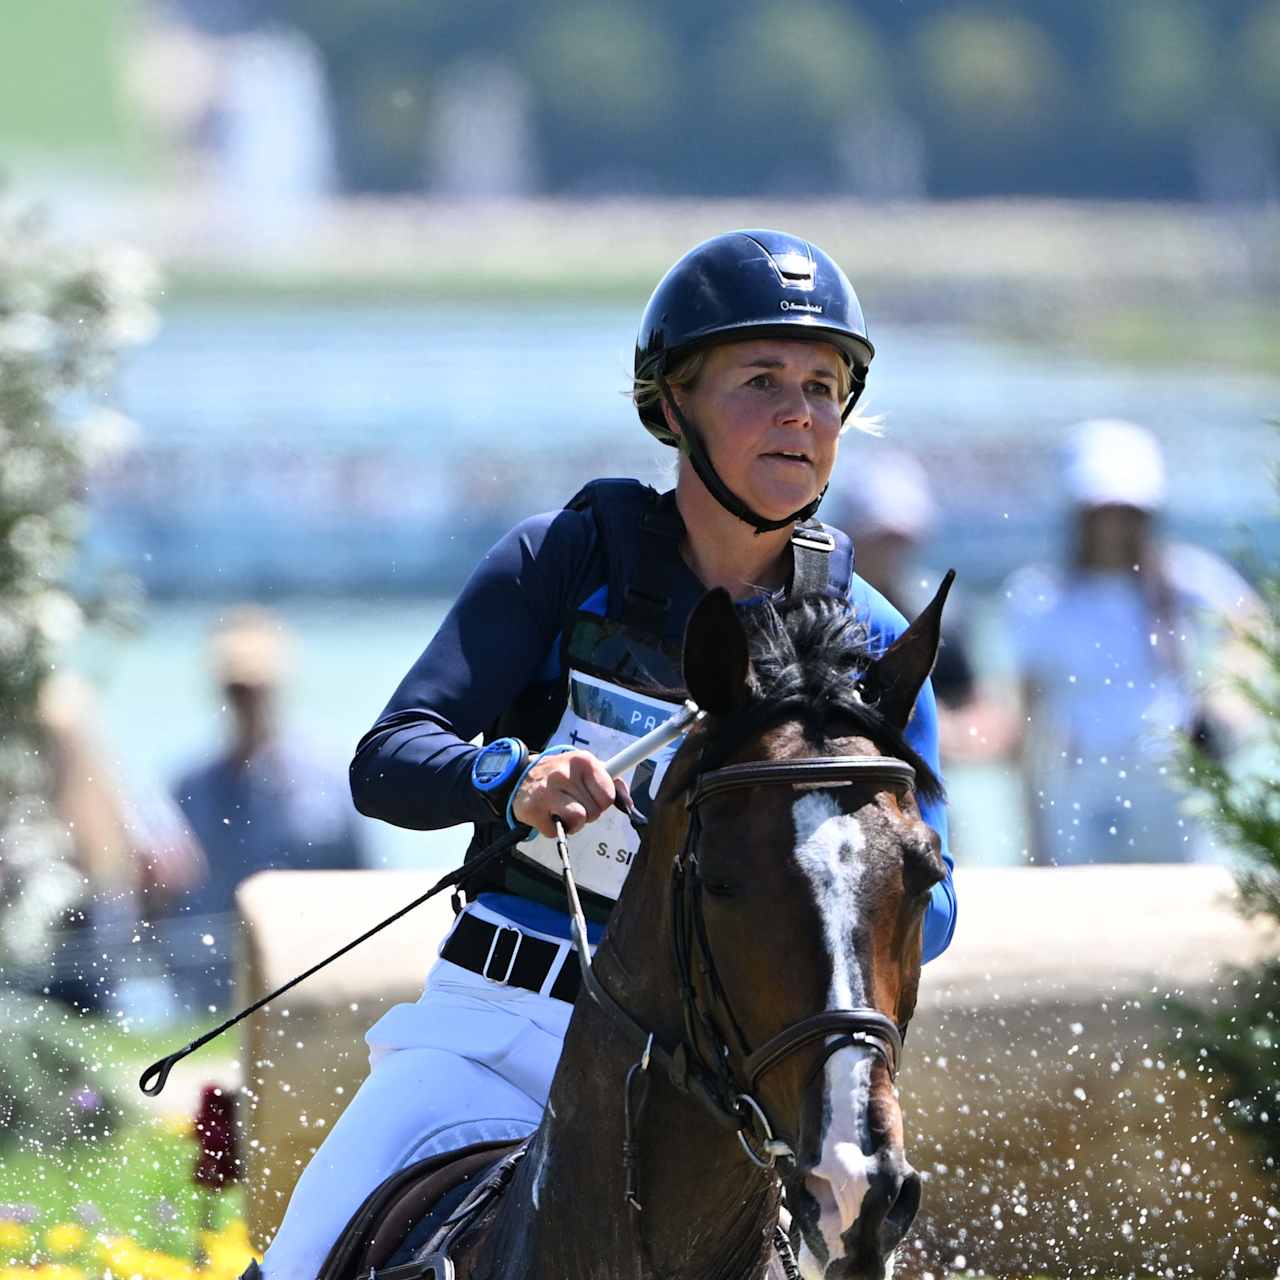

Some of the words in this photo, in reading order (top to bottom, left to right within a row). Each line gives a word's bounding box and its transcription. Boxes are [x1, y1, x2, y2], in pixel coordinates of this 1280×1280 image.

[630, 710, 666, 731] PA
[596, 841, 610, 858] S.
[615, 848, 634, 865] SI
